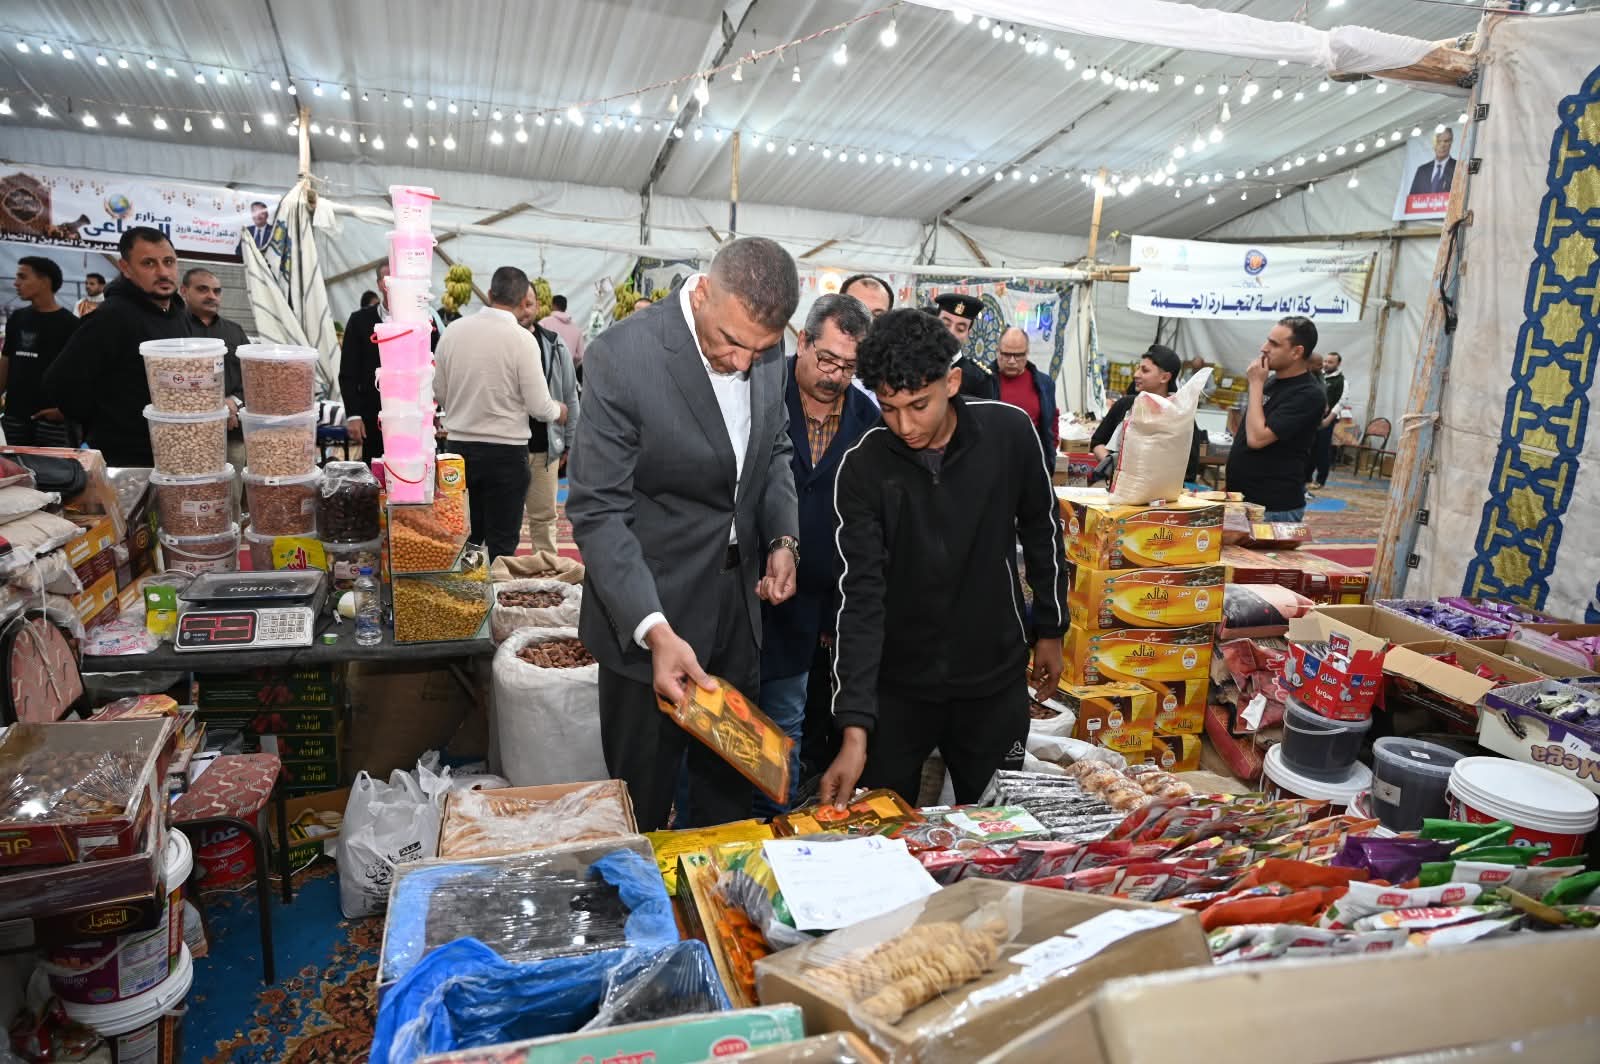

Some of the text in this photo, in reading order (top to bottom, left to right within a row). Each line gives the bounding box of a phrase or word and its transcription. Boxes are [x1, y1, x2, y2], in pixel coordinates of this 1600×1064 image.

[135, 212, 172, 223] مزارع
[1150, 288, 1350, 318] الشركة العامة لتجارة الجملة
[1320, 672, 1338, 685] عمان
